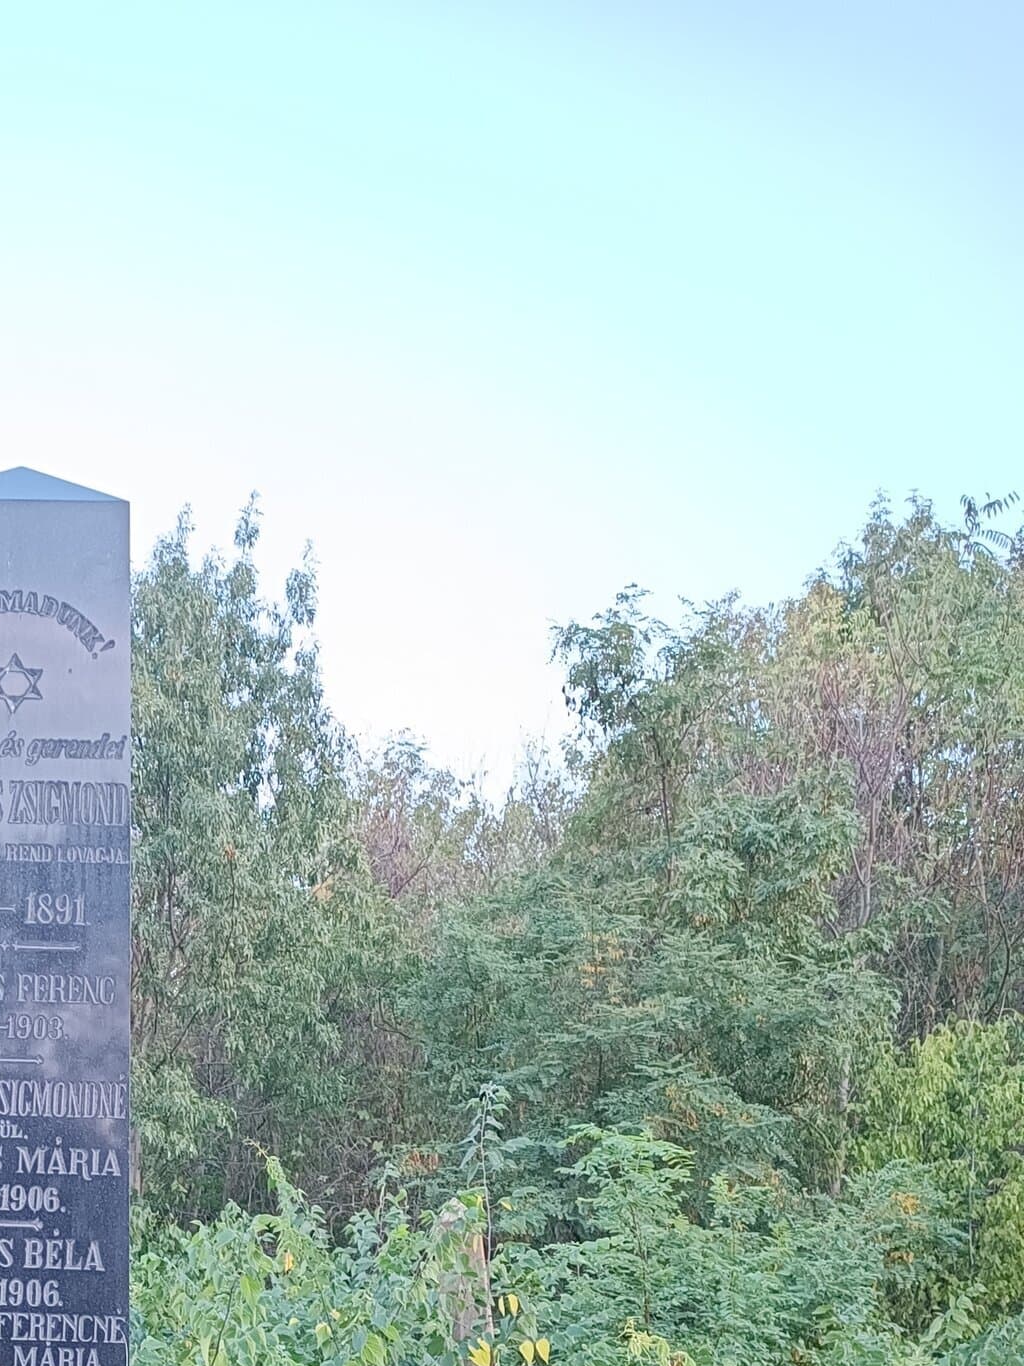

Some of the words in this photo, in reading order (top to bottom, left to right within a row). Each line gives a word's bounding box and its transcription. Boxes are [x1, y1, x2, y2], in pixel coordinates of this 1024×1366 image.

[7, 779, 130, 827] ZSIGMOND
[4, 843, 55, 863] REND
[16, 971, 115, 1005] FERENC
[15, 1135, 122, 1181] MÁRIA
[23, 1228, 106, 1272] BÉLA
